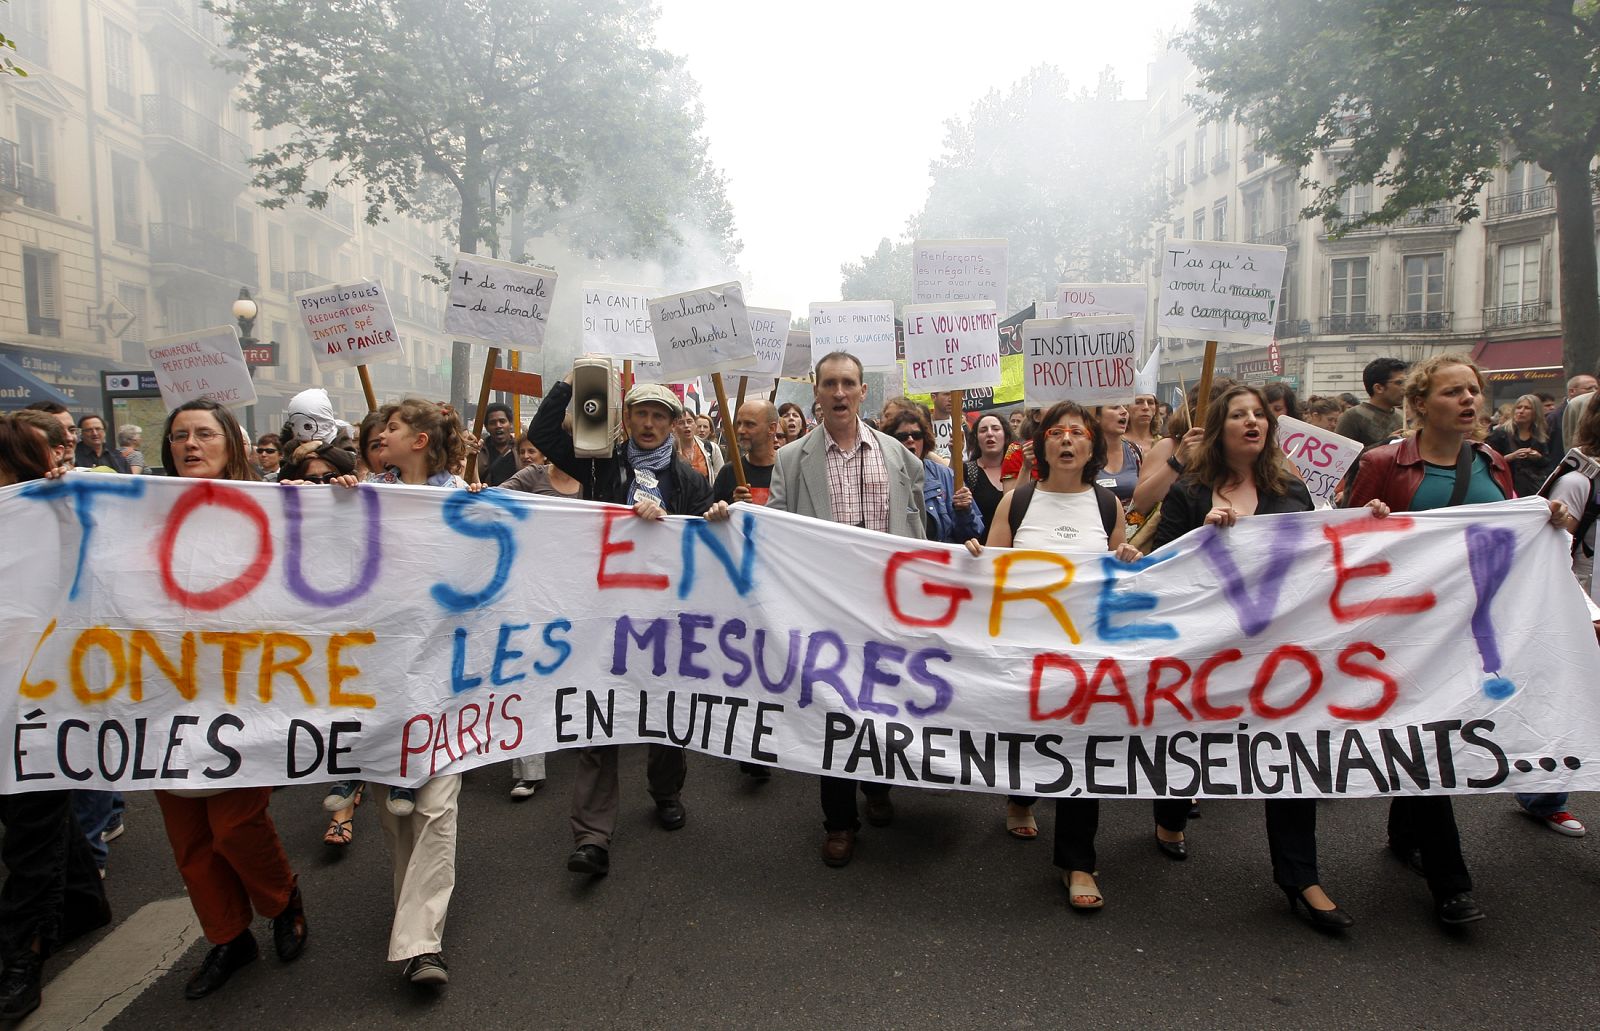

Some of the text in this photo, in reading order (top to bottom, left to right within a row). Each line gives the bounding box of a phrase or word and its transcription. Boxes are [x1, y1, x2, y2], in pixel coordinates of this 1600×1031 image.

[916, 264, 991, 280] les inégalités
[1168, 249, 1260, 281] T'as qu'à
[477, 274, 497, 290] de
[503, 278, 547, 298] morale
[917, 279, 997, 290] pour avoir une
[1167, 278, 1275, 299] avoir ta maison
[301, 286, 379, 310] PSYCHOLOGUES
[586, 294, 649, 311] LA CANTI
[917, 292, 943, 300] main
[1063, 290, 1096, 305] TOUS
[469, 299, 487, 312] de
[494, 299, 544, 321] chorale
[660, 297, 716, 322] évaluons
[1165, 301, 1185, 317] de
[585, 317, 653, 335] SI TU MÉR
[750, 319, 776, 333] NDRE
[814, 313, 891, 325] PLUS DE PUNITIONS
[908, 313, 997, 335] LE VOUVOIEMENT
[313, 323, 348, 341] INSTITS
[815, 333, 895, 345] POUR LES SAUVAGEONS
[149, 342, 201, 360] CONCURRENCE
[327, 330, 396, 355] AU PANIER
[754, 337, 782, 349] ARCOS
[945, 338, 960, 354] EN
[1030, 329, 1135, 357] INSTITUTEURS
[162, 352, 228, 372] PERFORMANCE
[242, 349, 269, 361] TRO
[756, 350, 782, 361] MAIN
[912, 352, 999, 379] PETITE SECTION
[1033, 357, 1134, 387] PROFITEURS
[1, 385, 31, 398] onde
[165, 378, 210, 393] VIVE LA
[207, 388, 240, 401] RANCE
[962, 399, 984, 410] ARIS
[1282, 432, 1339, 468] CRS
[19, 478, 528, 614] TOUS
[596, 506, 758, 600] EN
[883, 515, 1437, 646] GREVE
[18, 612, 1400, 727] CONTRE LES MESURES DARCOS
[14, 707, 246, 783] ÉCOLES
[286, 717, 362, 781] DE
[399, 692, 524, 779] PARIS
[555, 686, 616, 743] EN
[637, 689, 785, 764] LUTTE
